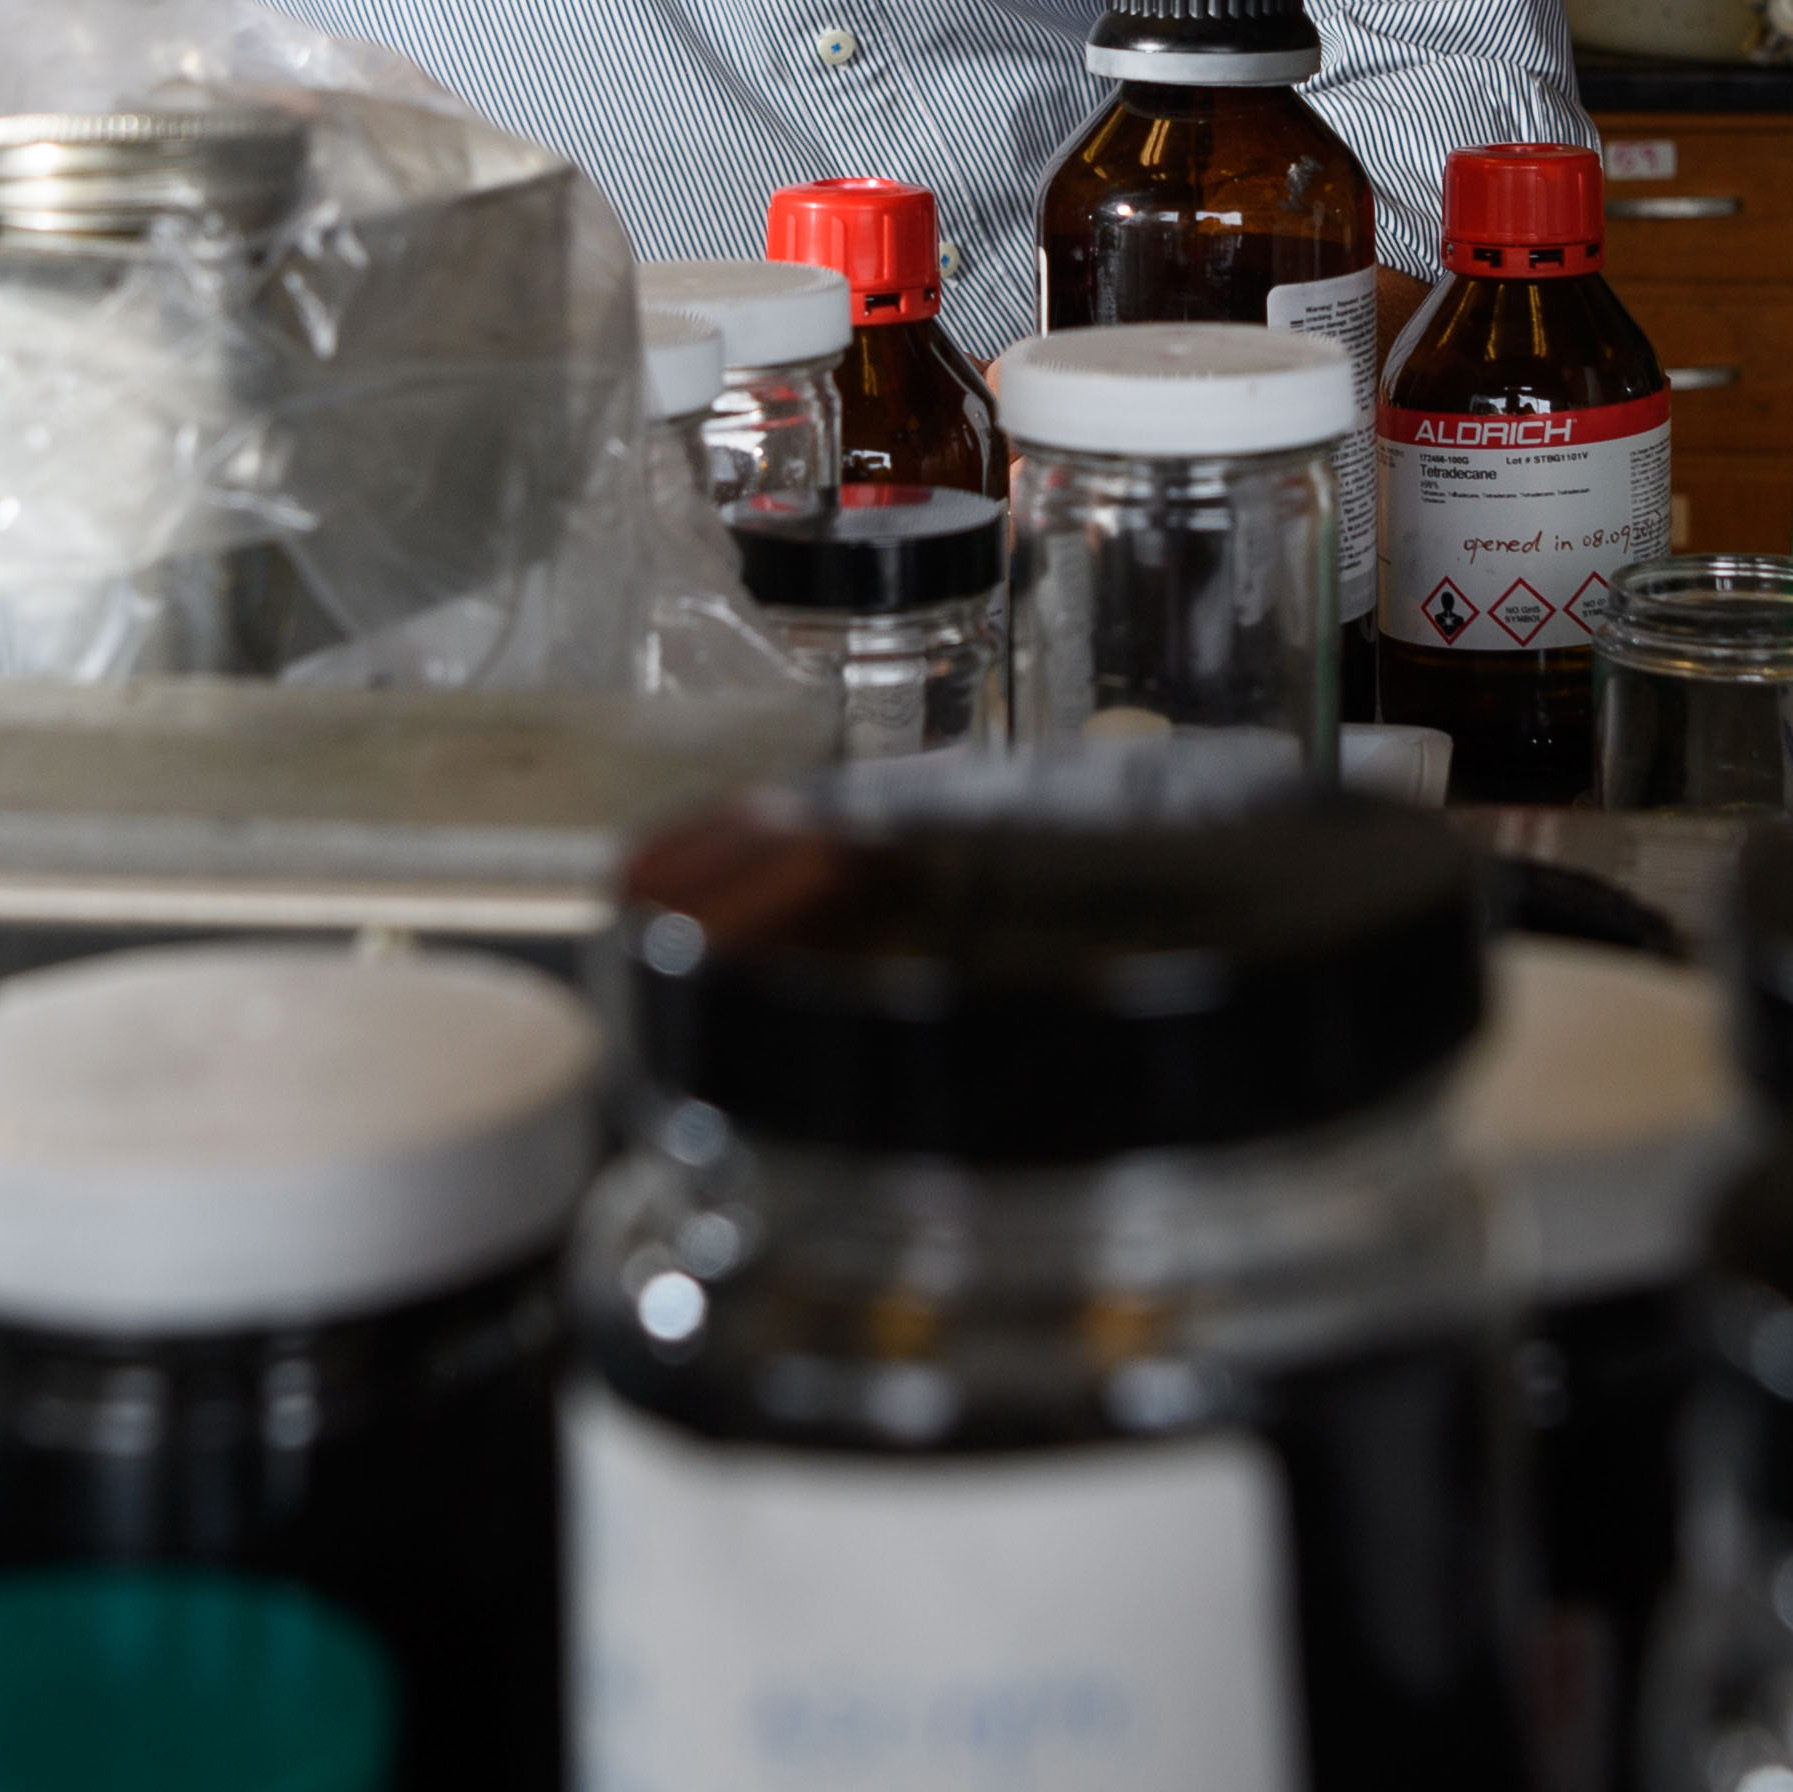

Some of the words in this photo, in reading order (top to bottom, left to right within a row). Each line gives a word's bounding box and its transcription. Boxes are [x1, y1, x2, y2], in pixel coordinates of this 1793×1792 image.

[1414, 418, 1572, 445] ALDRICH
[1506, 456, 1523, 465] Lot
[1420, 464, 1497, 480] Tetradecane
[1463, 530, 1543, 564] opened
[1555, 535, 1573, 551] in
